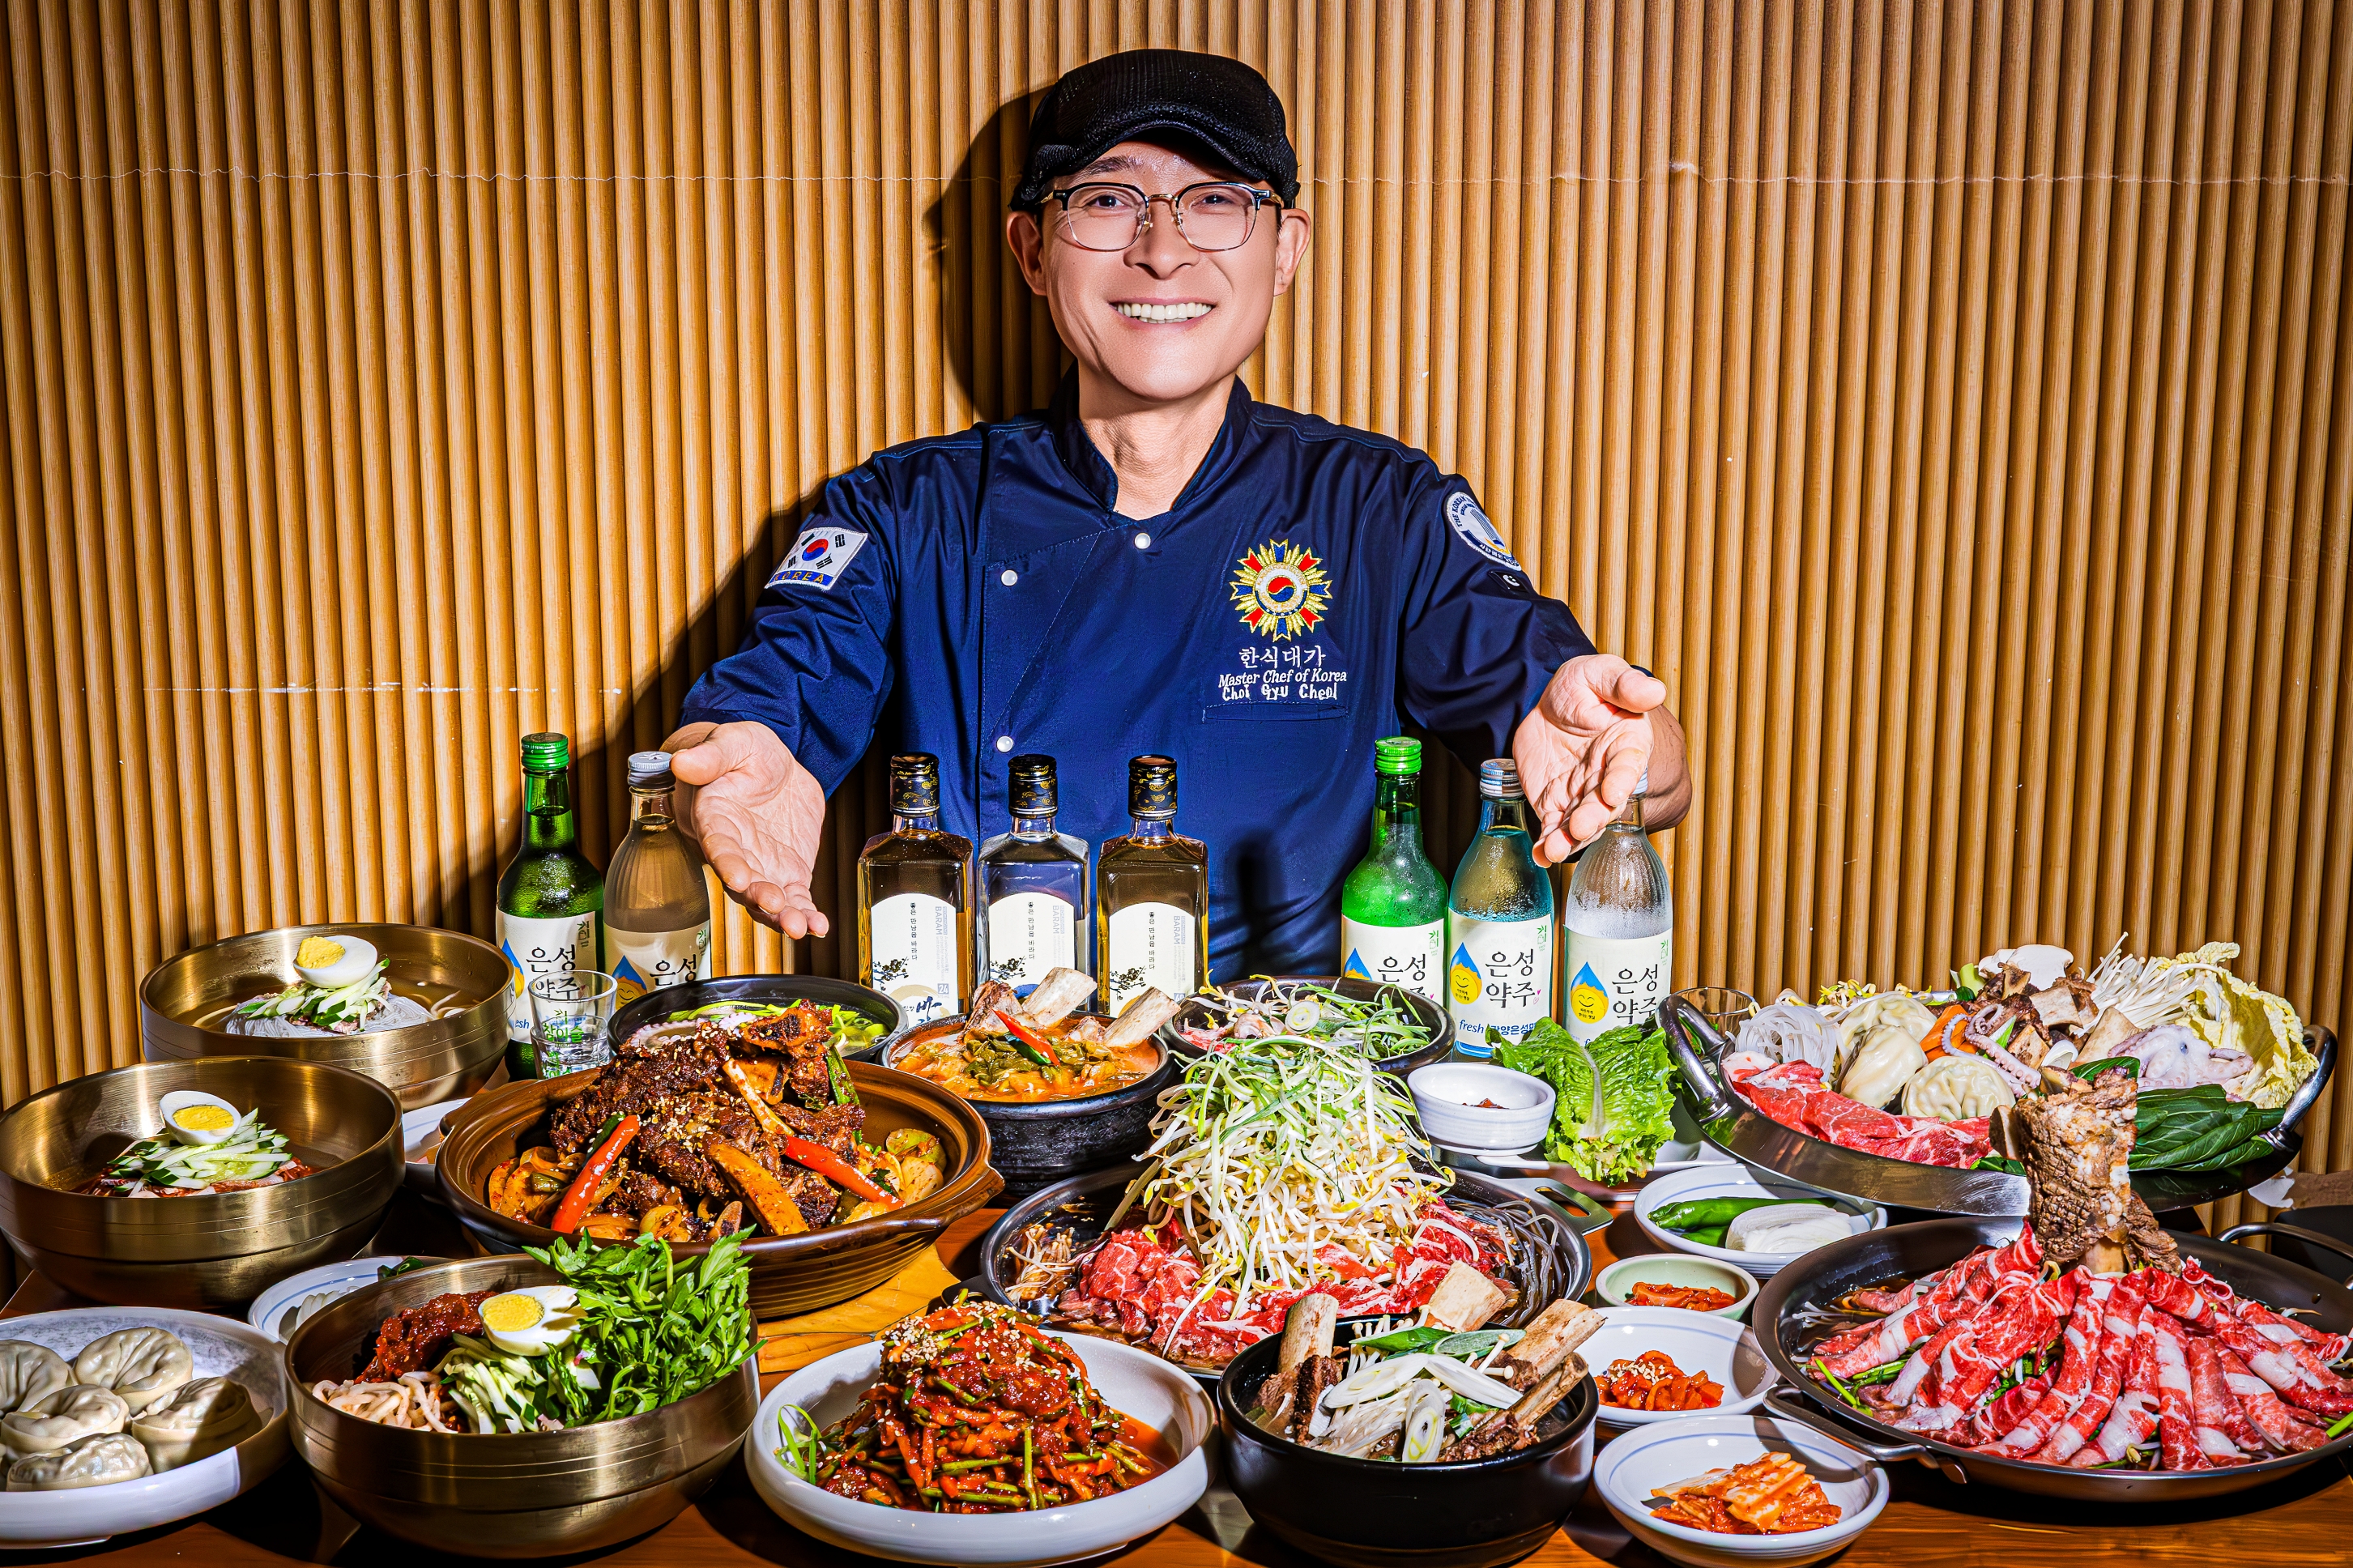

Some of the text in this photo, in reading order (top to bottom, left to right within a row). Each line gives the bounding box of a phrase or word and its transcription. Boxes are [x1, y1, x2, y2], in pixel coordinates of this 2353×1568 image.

[774, 571, 825, 584] KOREA
[1218, 668, 1347, 688] Master Chef of Korea
[1222, 682, 1338, 701] Choi Gyu Cheol
[526, 944, 576, 974] 은성
[650, 953, 697, 986] 은성
[1377, 953, 1426, 982] 은성
[1485, 948, 1534, 978] 은성
[535, 977, 580, 1001] 약주
[939, 984, 948, 995] 24
[1611, 964, 1658, 995] 은성
[1486, 982, 1536, 1008] 약주
[1613, 996, 1657, 1025] 약주
[543, 1023, 584, 1043] 참이슬
[1460, 1019, 1485, 1034] fresh
